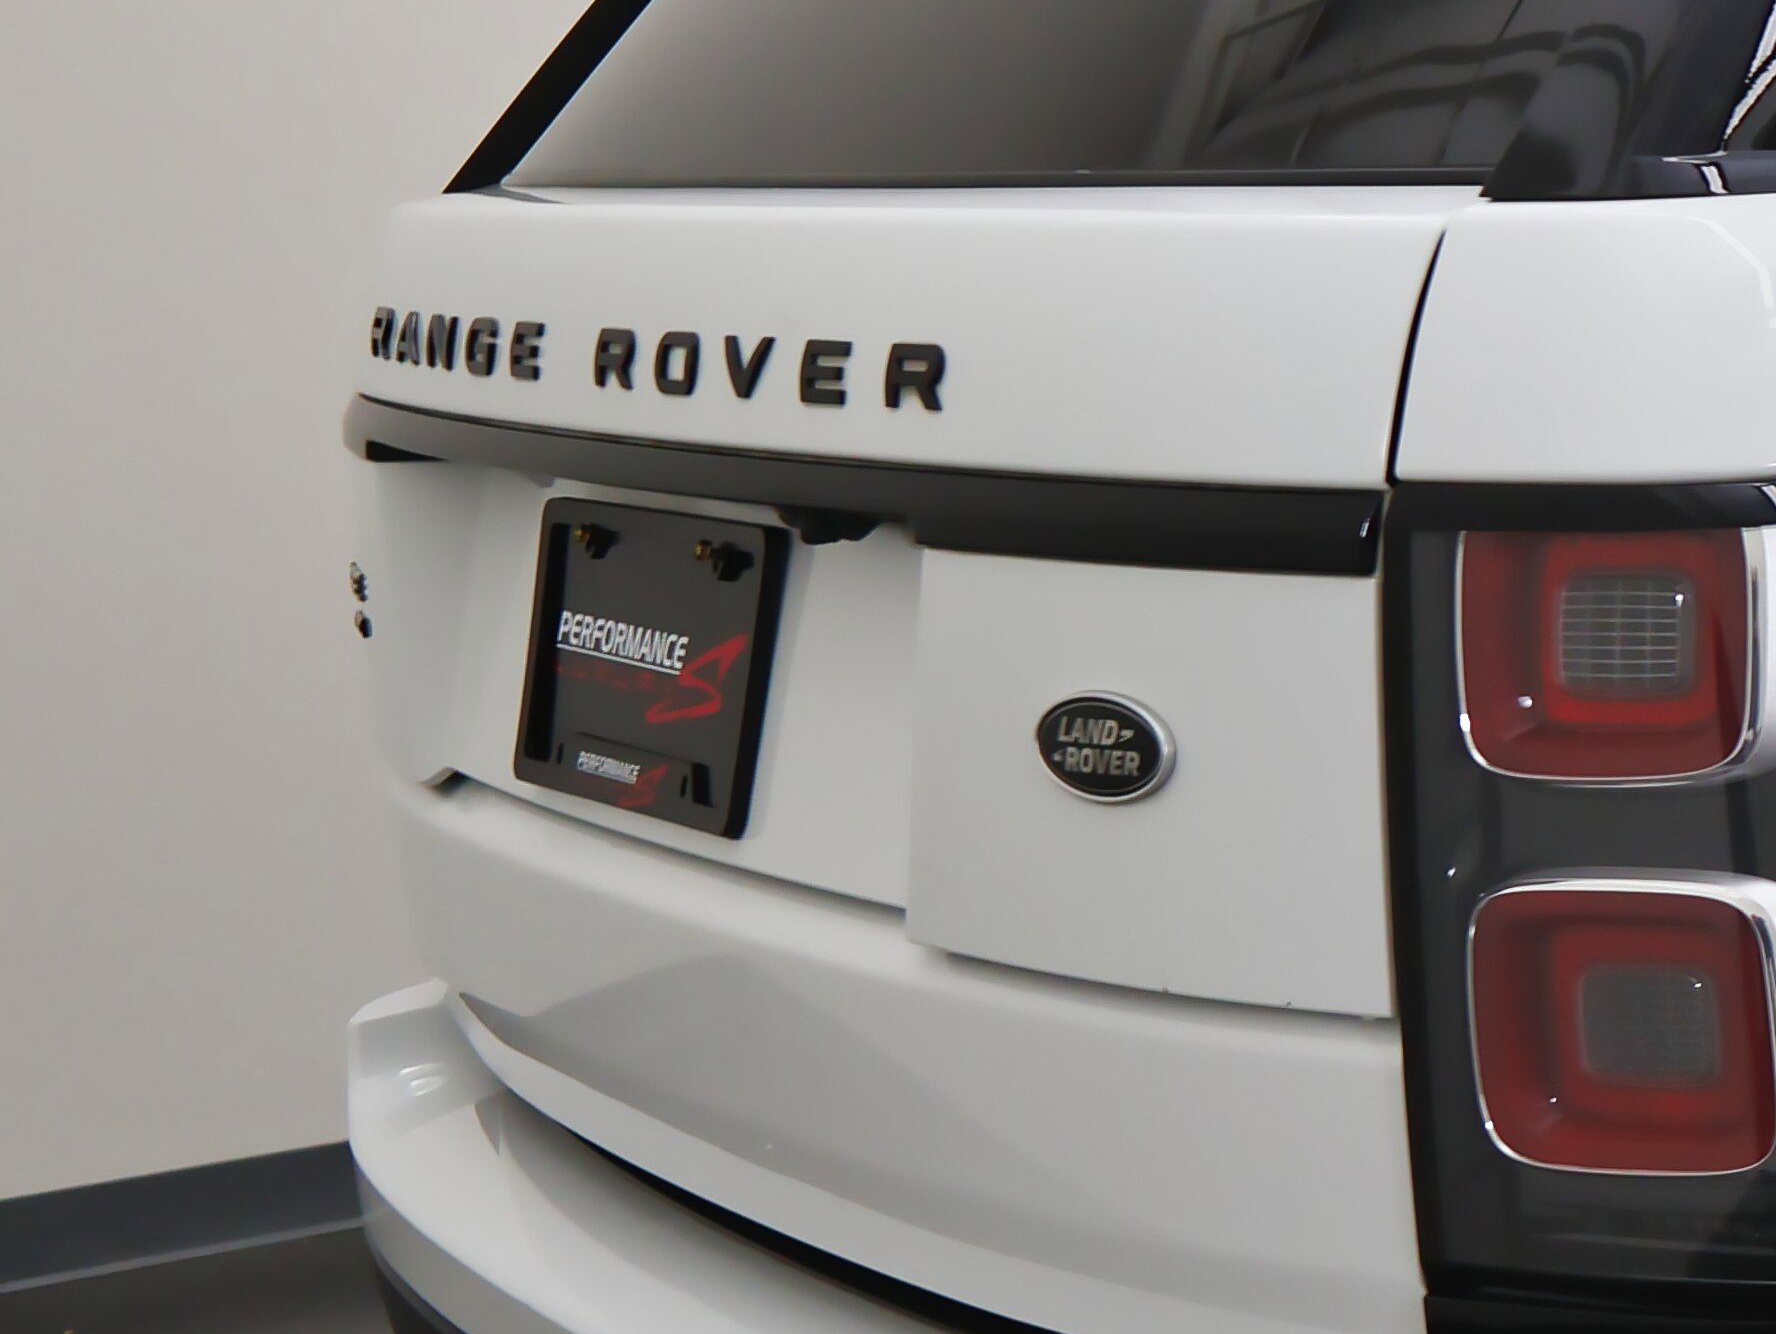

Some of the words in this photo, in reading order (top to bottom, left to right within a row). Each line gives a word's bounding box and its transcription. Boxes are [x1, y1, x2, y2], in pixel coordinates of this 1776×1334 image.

[371, 307, 546, 381] RANGE
[594, 328, 946, 411] ROVER
[557, 610, 690, 670] PERFORMANCE
[1063, 746, 1141, 776] ROVER
